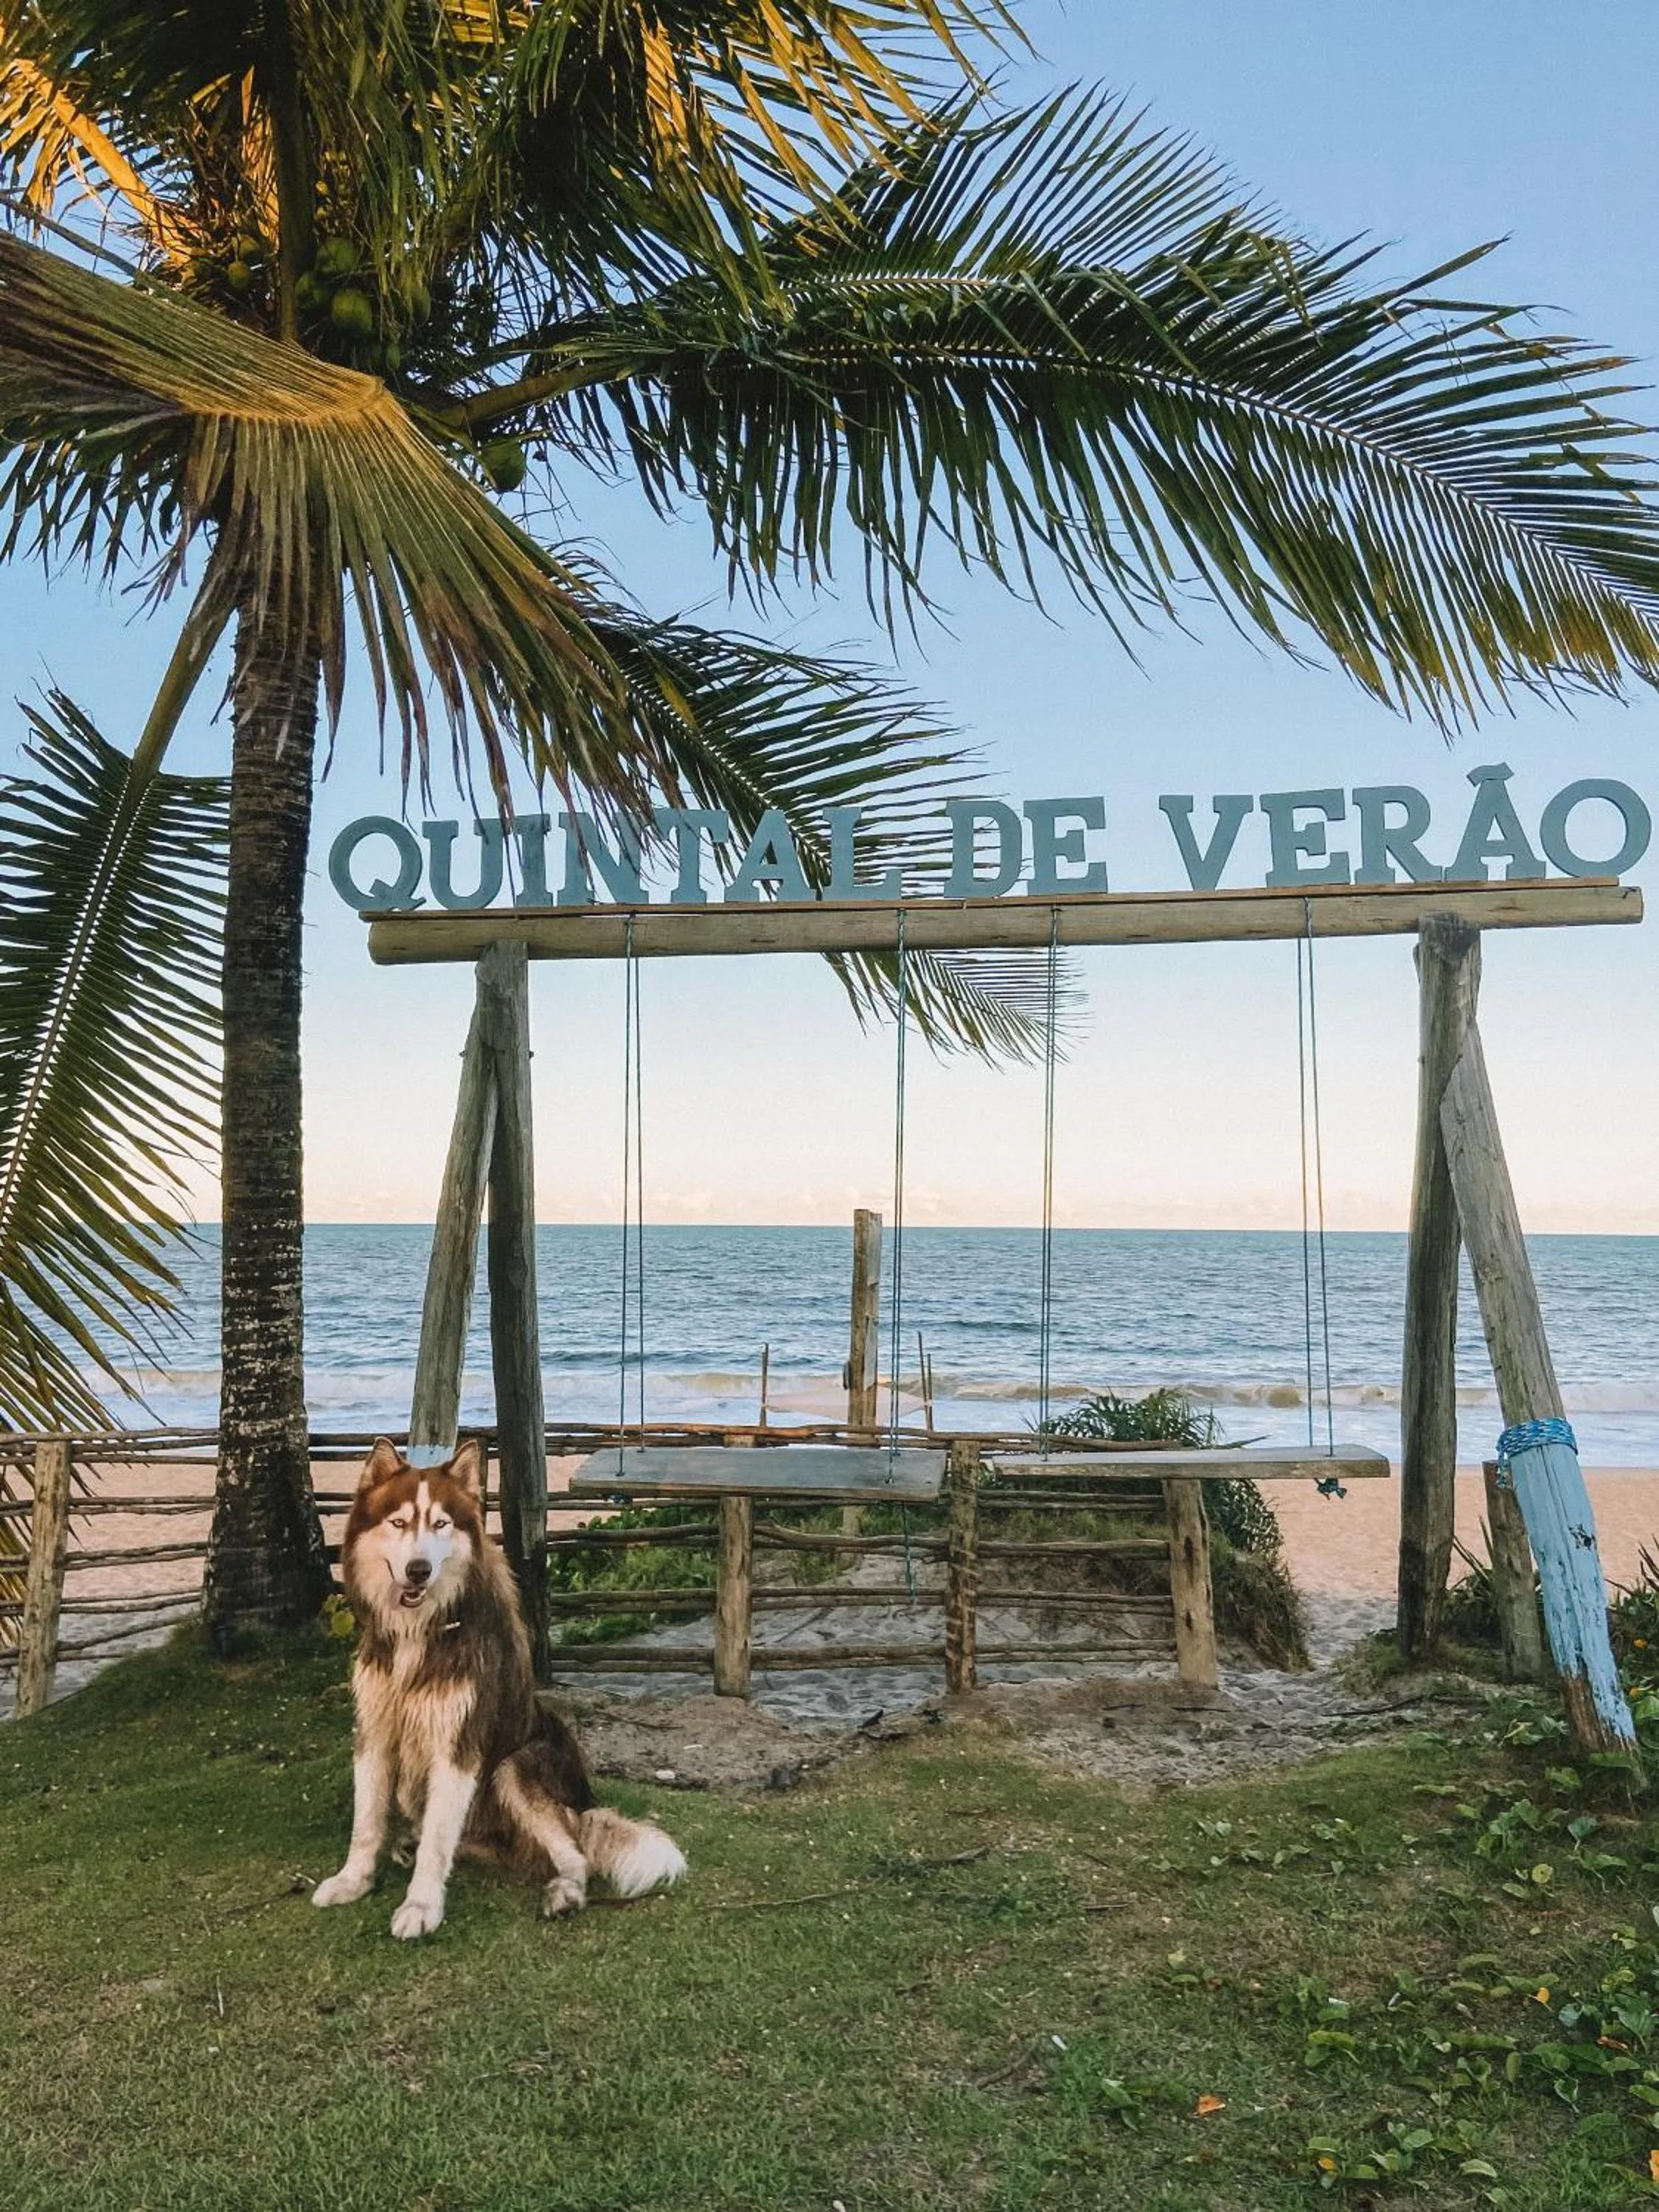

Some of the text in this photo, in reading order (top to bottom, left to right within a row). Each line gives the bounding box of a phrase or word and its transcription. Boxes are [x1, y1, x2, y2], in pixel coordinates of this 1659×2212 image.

[329, 762, 1652, 911] QUINTAL DE VERÃO
